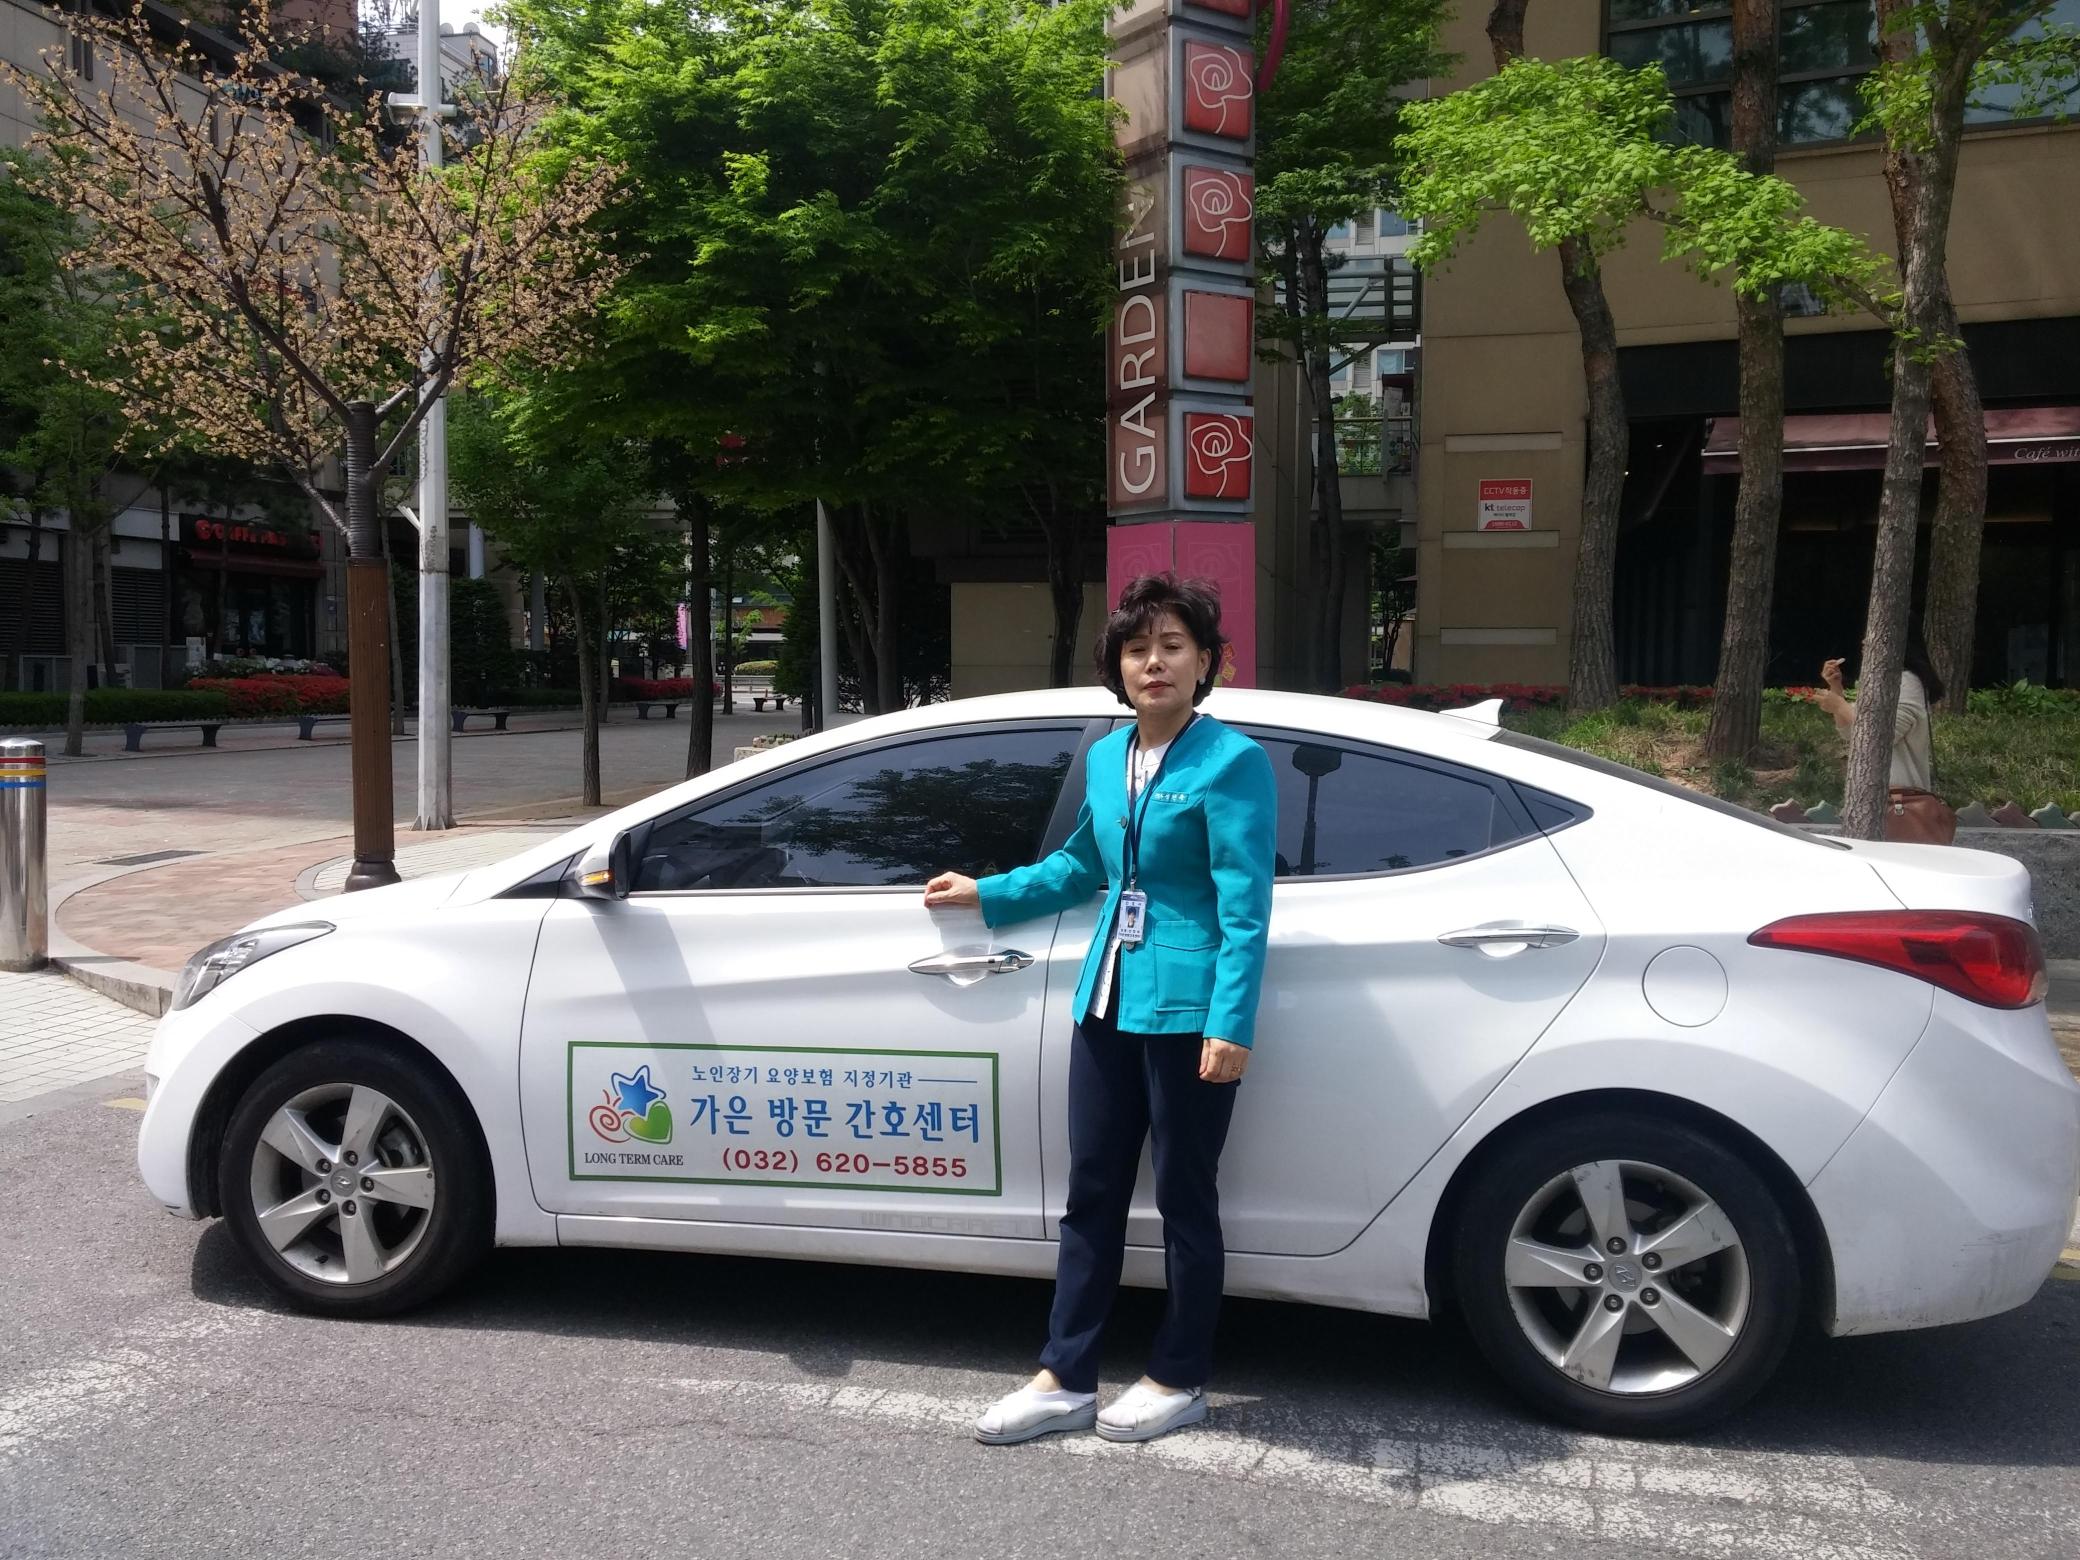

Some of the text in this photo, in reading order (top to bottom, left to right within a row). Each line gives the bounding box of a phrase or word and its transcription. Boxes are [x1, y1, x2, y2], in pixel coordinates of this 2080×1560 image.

[1119, 194, 1156, 495] GARDEN
[2014, 446, 2080, 461] Café wit
[1484, 503, 1495, 512] kt
[692, 1065, 913, 1089] 노인장기 요양보험 지정기관
[690, 1094, 979, 1143] 가은 방문 간호센터
[584, 1152, 684, 1166] LONG TERM CARE
[723, 1147, 967, 1178] (032) 620-5855
